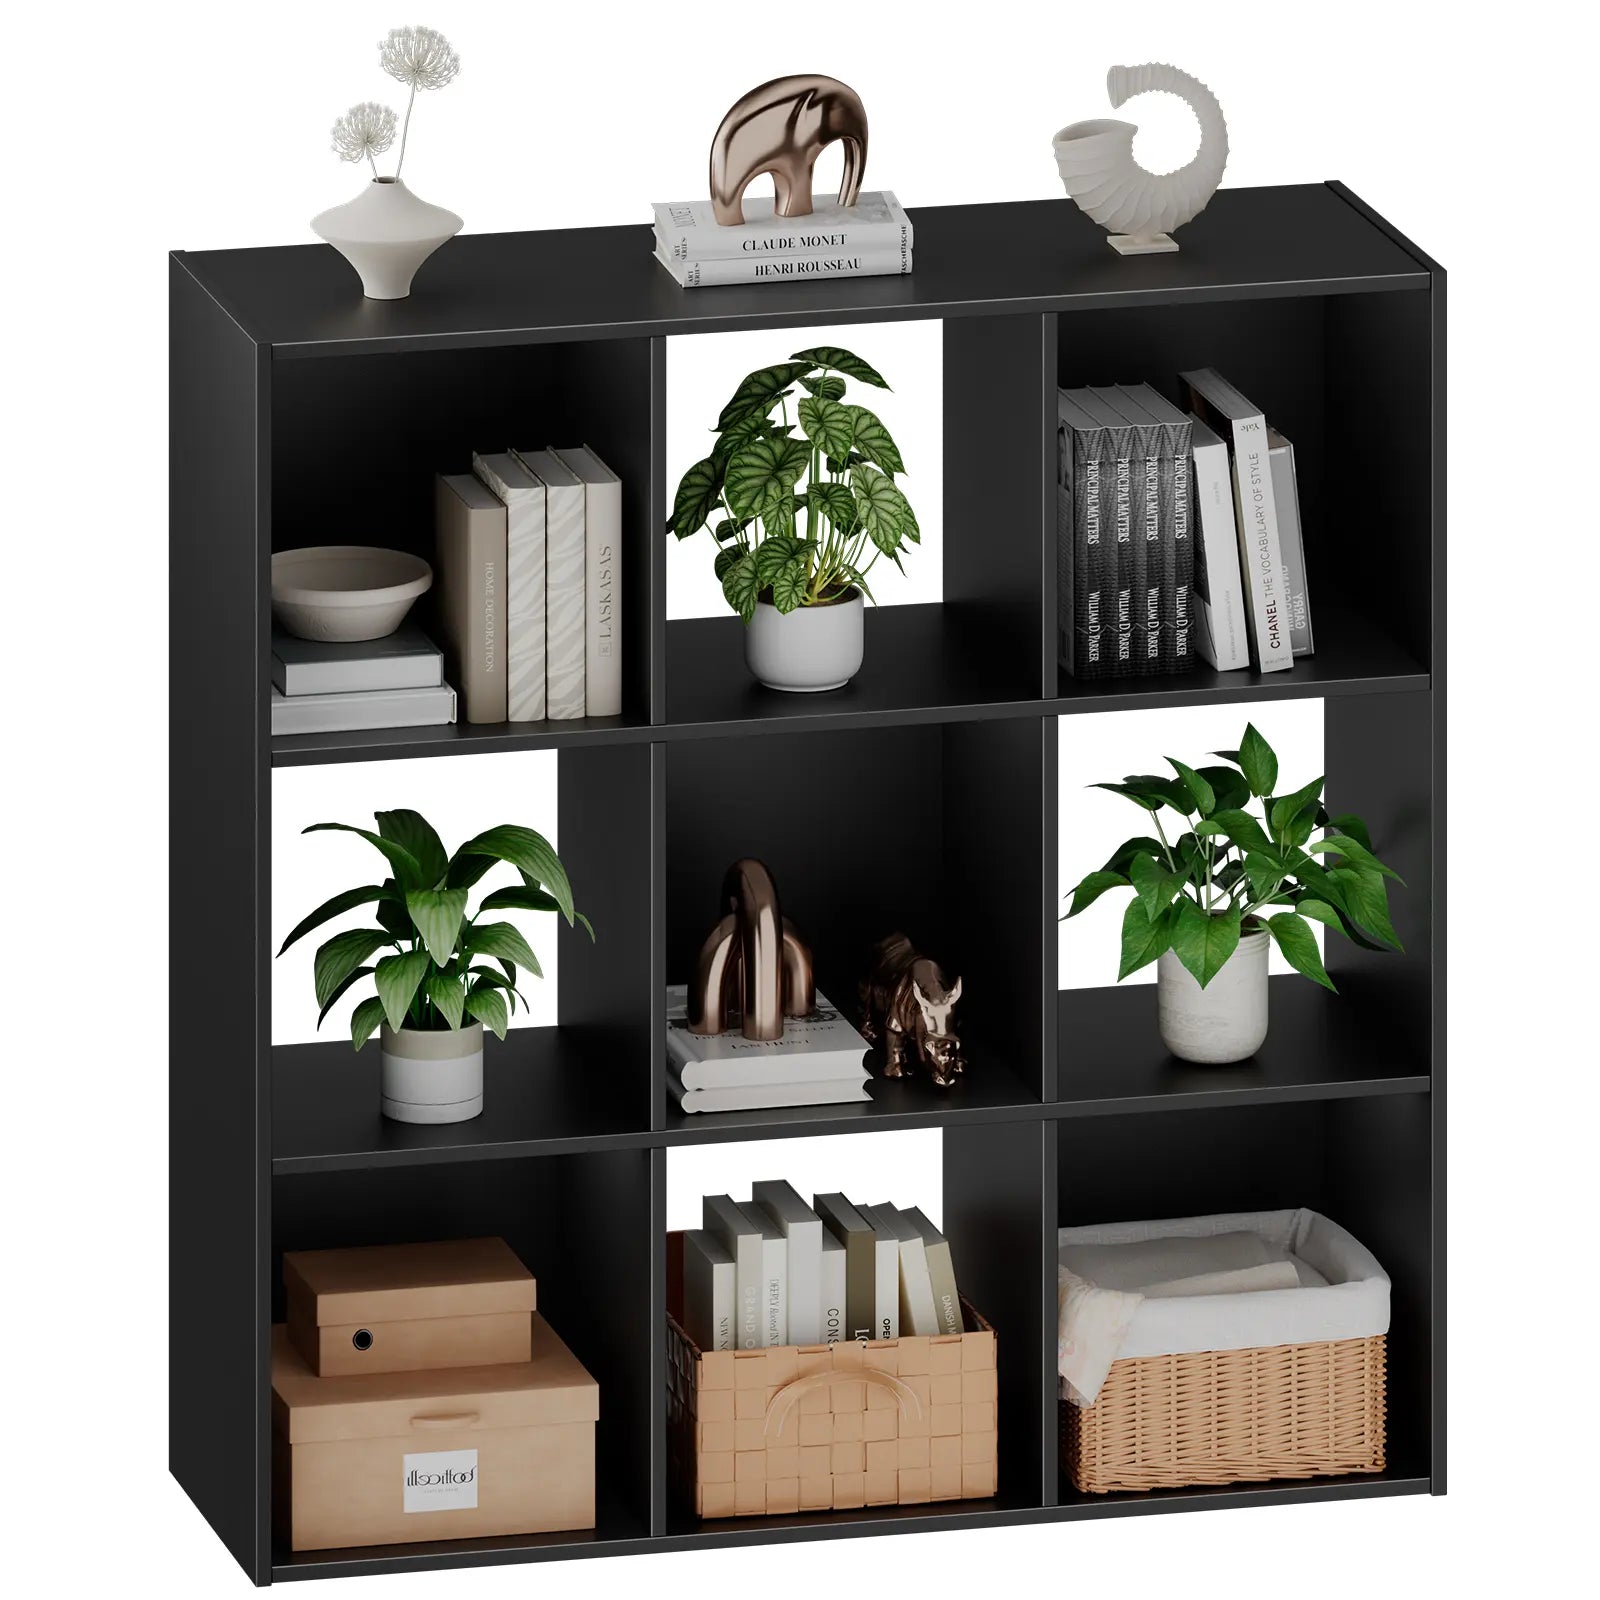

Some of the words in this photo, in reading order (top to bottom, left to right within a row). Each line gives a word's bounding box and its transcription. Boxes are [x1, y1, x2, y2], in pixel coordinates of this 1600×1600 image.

[742, 237, 796, 251] CLAUDE
[800, 234, 848, 248] MONET
[687, 270, 695, 283] ART
[755, 262, 794, 276] HENRI
[797, 258, 862, 273] ROUSSEAU
[1240, 422, 1260, 433] Yale
[1087, 459, 1099, 504] PRINCIPAL
[1117, 458, 1129, 503] PRINCIPAL
[1146, 456, 1158, 500] PRINCIPAL
[1175, 454, 1187, 499] PRINCIPAL
[1248, 452, 1261, 485] STYLE
[1252, 487, 1263, 502] OF
[1088, 505, 1100, 545] MATTERS
[1117, 503, 1130, 543] MATTERS
[1146, 501, 1159, 541] MATTERS
[1175, 500, 1187, 540] MATTERS
[1255, 506, 1271, 575] VOCABULARY
[485, 563, 495, 597] HOME
[599, 546, 612, 640] LASKASAS
[1264, 578, 1273, 598] THE
[485, 600, 496, 673] DECORATION
[1088, 624, 1100, 634] D.
[1119, 622, 1130, 632] D.
[1148, 620, 1160, 630] D.
[1176, 619, 1188, 628] D.
[1266, 599, 1281, 649] CHANEL
[721, 1317, 729, 1336] NEW
[744, 1287, 756, 1332] GRAND
[942, 1296, 955, 1326] DANISH
